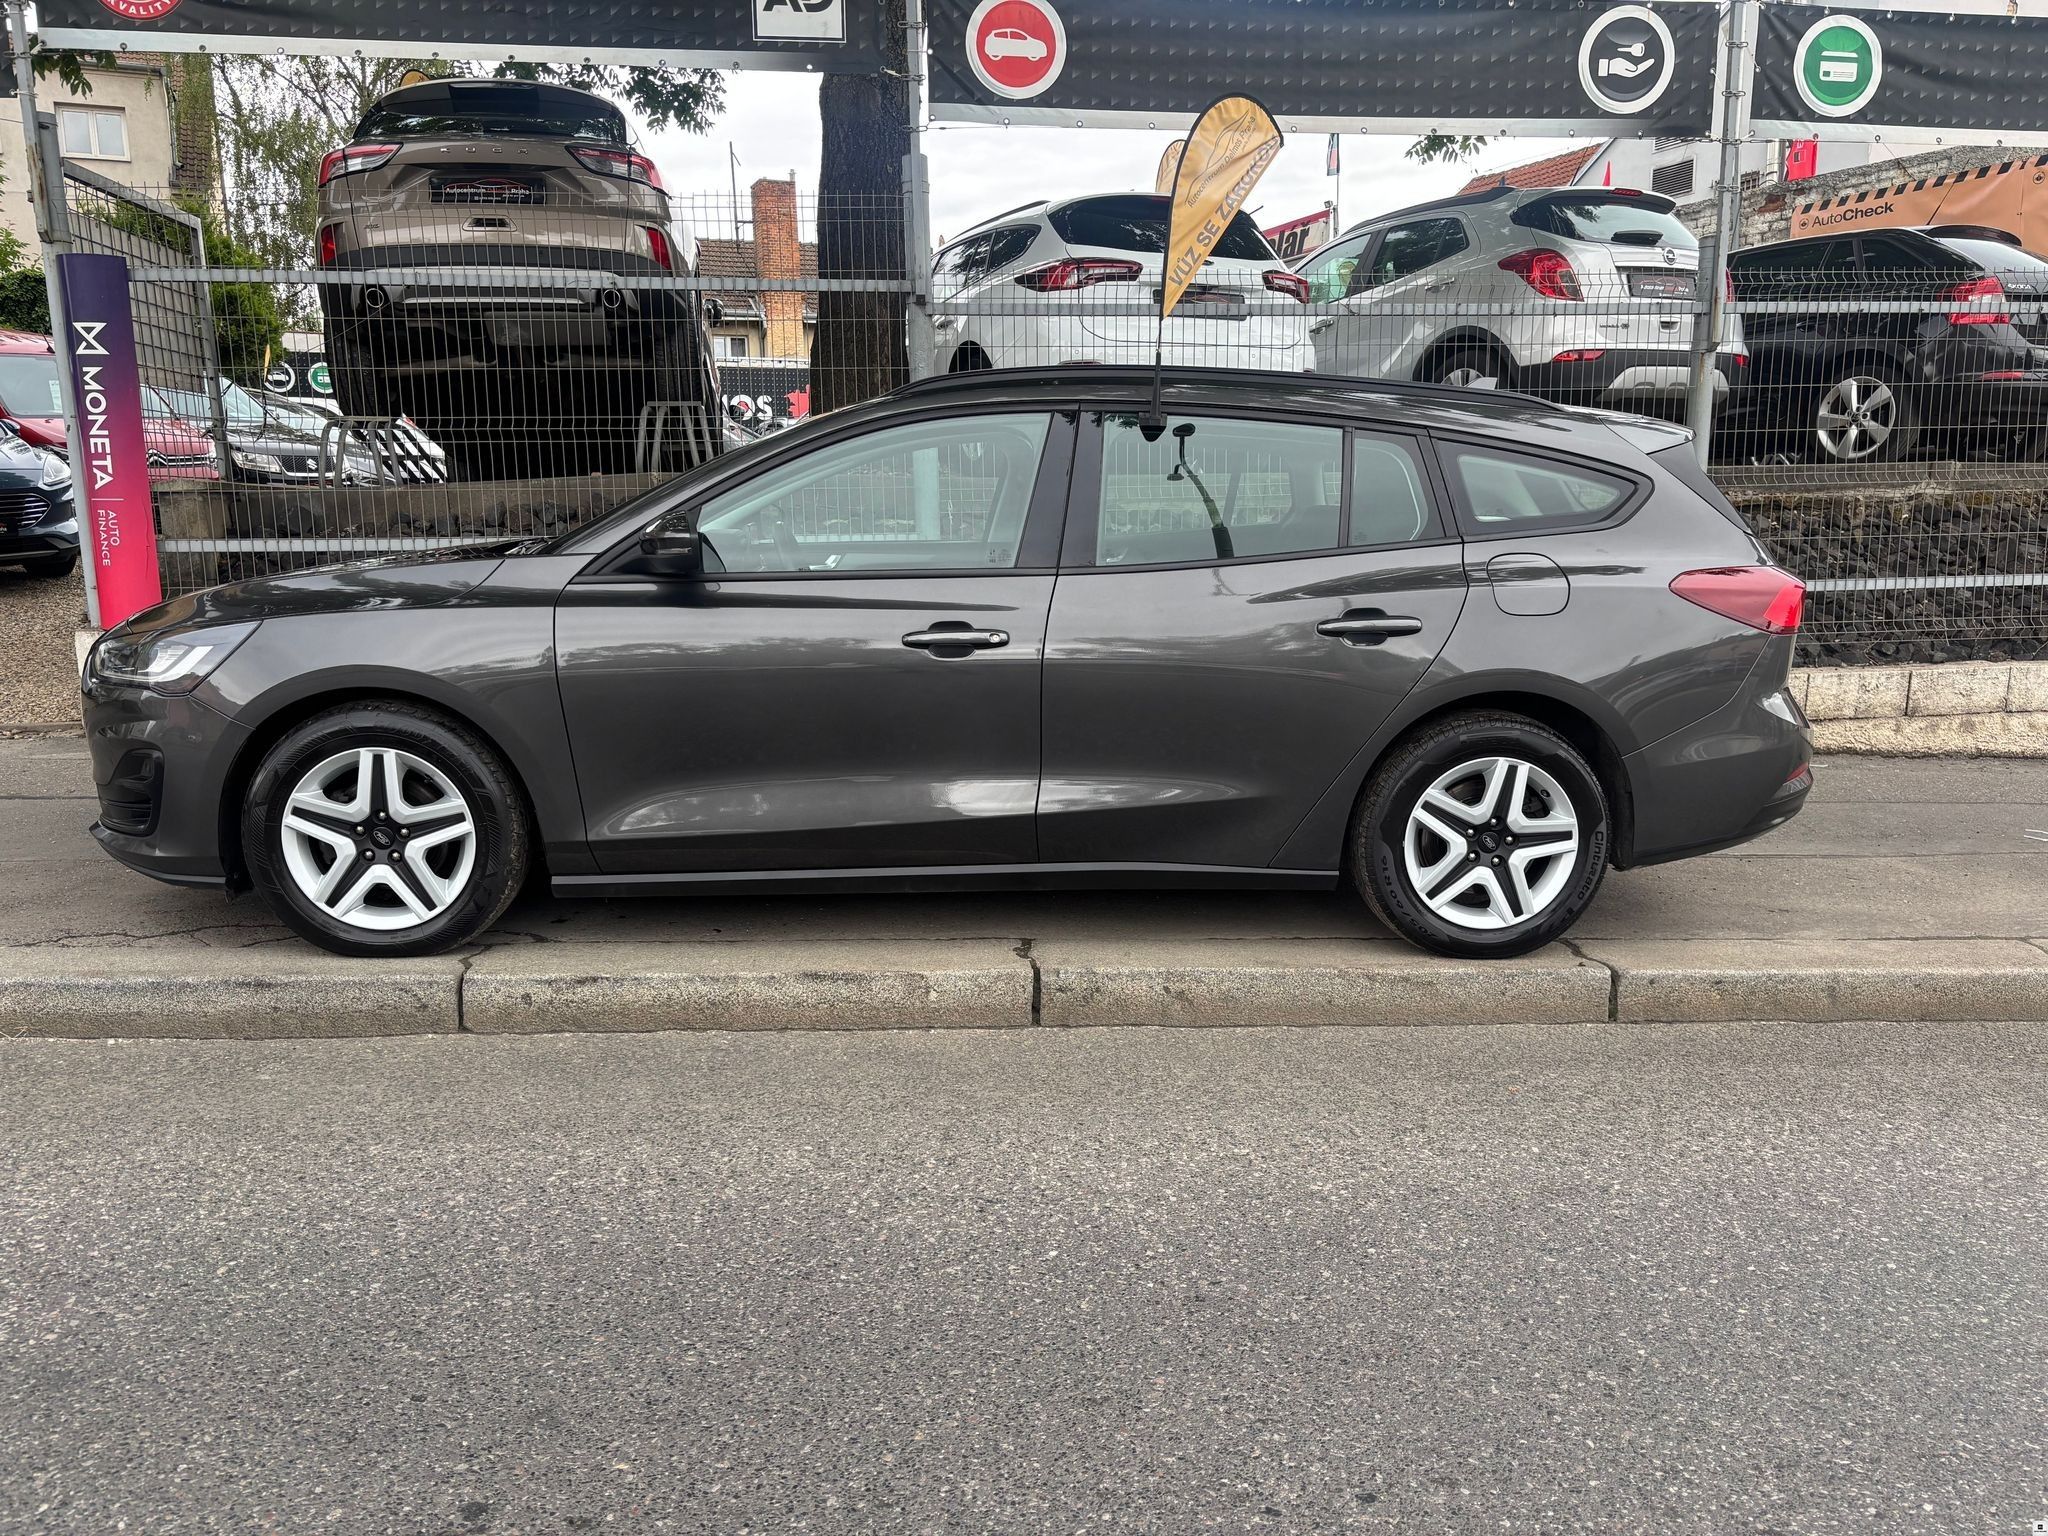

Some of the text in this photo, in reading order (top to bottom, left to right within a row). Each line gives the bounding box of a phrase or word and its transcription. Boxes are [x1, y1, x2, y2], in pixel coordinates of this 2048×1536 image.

[1811, 201, 1895, 228] AutoCheck
[1168, 245, 1201, 286] VŮZ
[1196, 219, 1220, 247] SE
[82, 366, 114, 490] MONETA
[98, 509, 111, 567] FINANCE
[107, 510, 120, 546] AUTO
